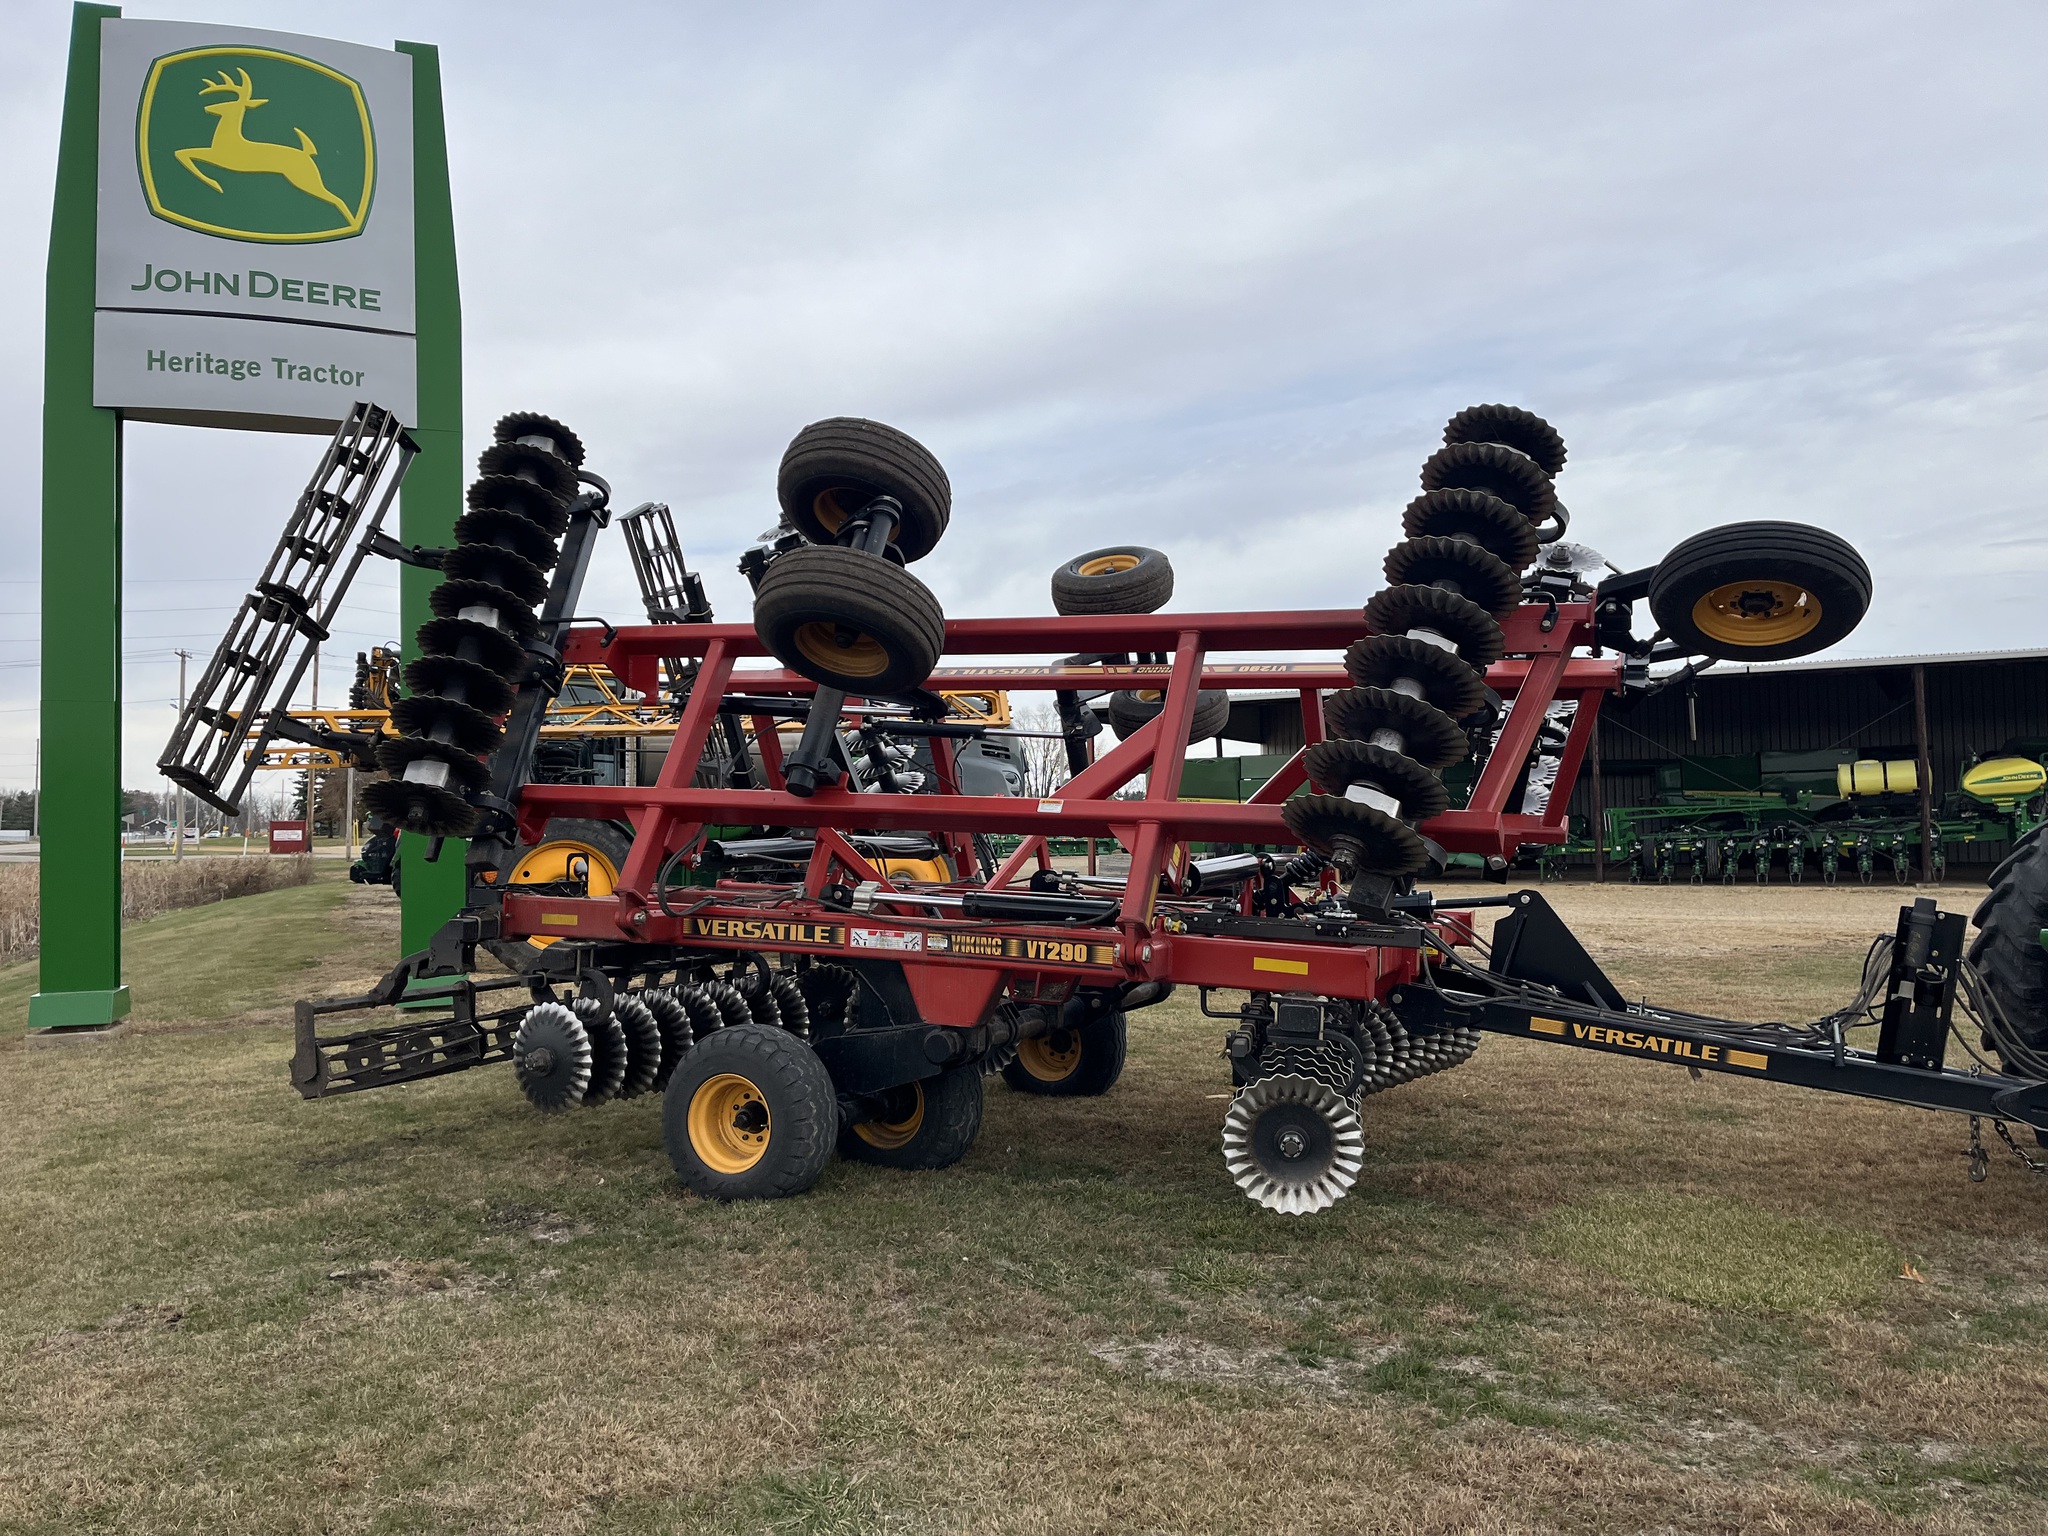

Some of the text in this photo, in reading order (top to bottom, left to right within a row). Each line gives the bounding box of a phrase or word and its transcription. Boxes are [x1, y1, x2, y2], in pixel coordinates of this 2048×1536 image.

[131, 264, 381, 312] JOHN DEERE
[147, 350, 365, 386] Heritage Tractor
[943, 667, 1050, 675] VERSATILE
[697, 918, 832, 944] VERSATILE
[951, 934, 1003, 956] VIKING
[1026, 940, 1088, 963] VT290
[1572, 1023, 1721, 1062] VERSATILE
